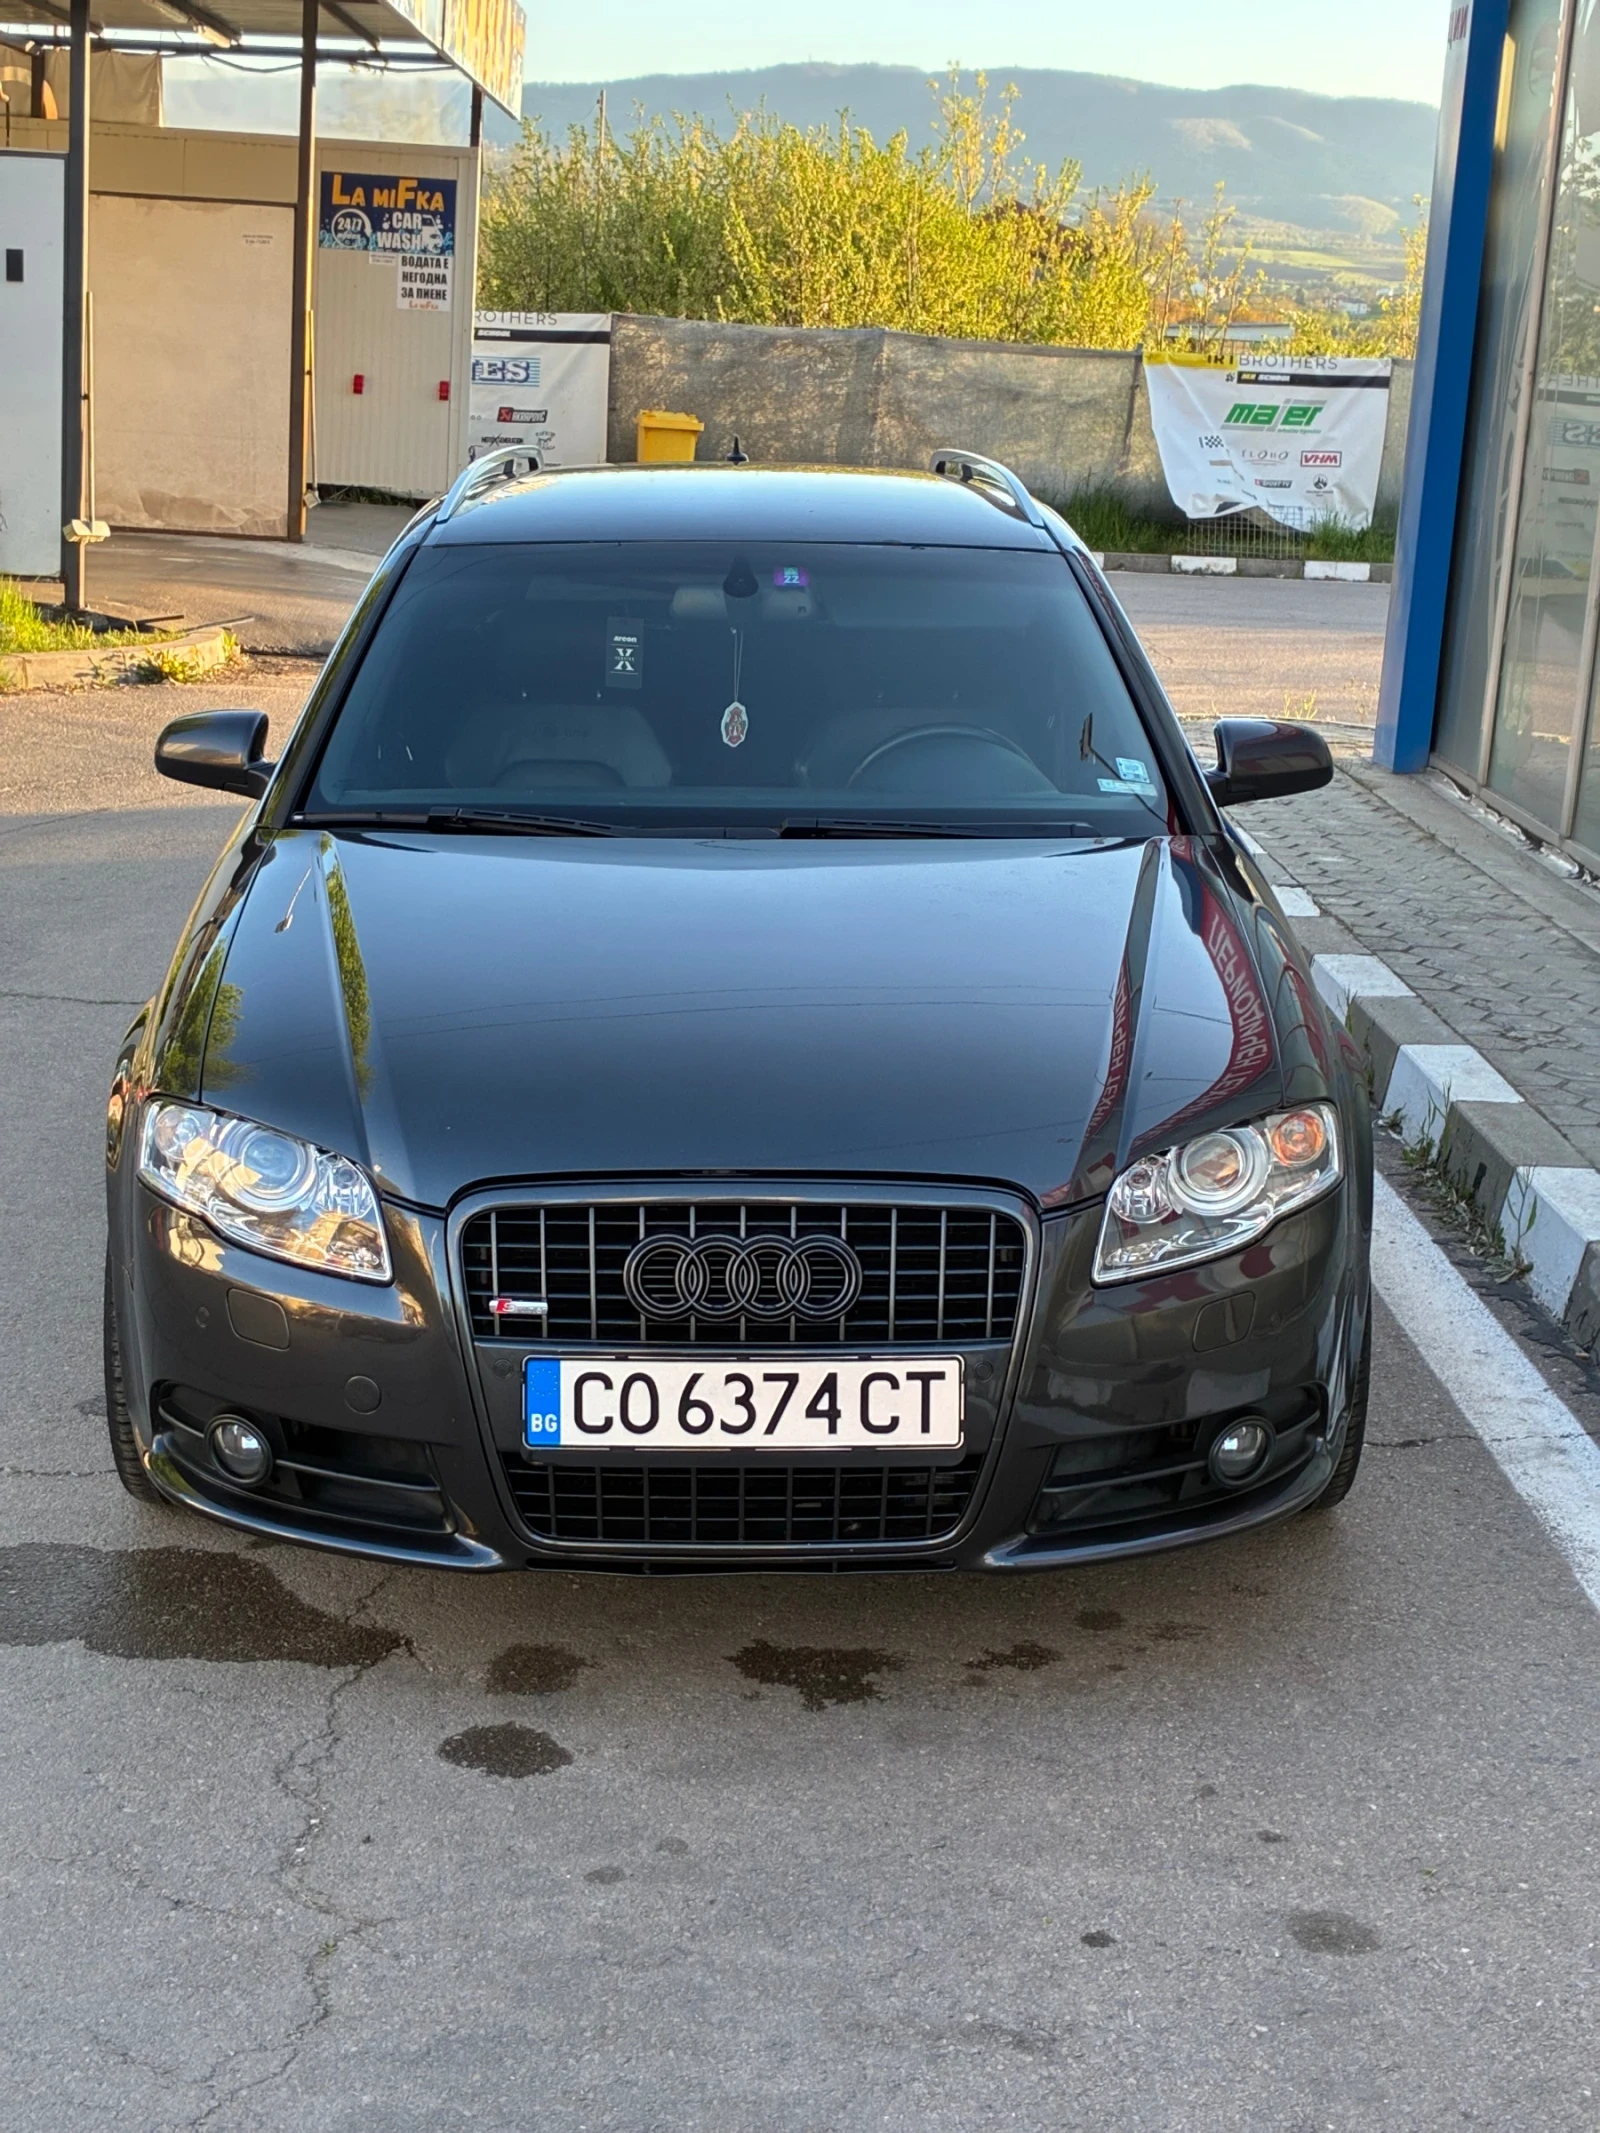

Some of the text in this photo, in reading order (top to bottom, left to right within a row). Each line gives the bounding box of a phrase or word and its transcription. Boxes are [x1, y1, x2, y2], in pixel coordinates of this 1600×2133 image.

[392, 212, 422, 230] CAR
[377, 231, 421, 250] WASH
[401, 255, 442, 269] ВОДАТА
[444, 257, 450, 269] Е
[402, 271, 447, 286] НЕГОДНА
[401, 287, 447, 300] ЗА ПИЕНЕ
[1239, 353, 1338, 370] BROTHERS
[1303, 454, 1338, 464] VHM
[677, 1372, 842, 1434] 6374
[860, 1371, 947, 1434] CT
[531, 1413, 558, 1433] BG
